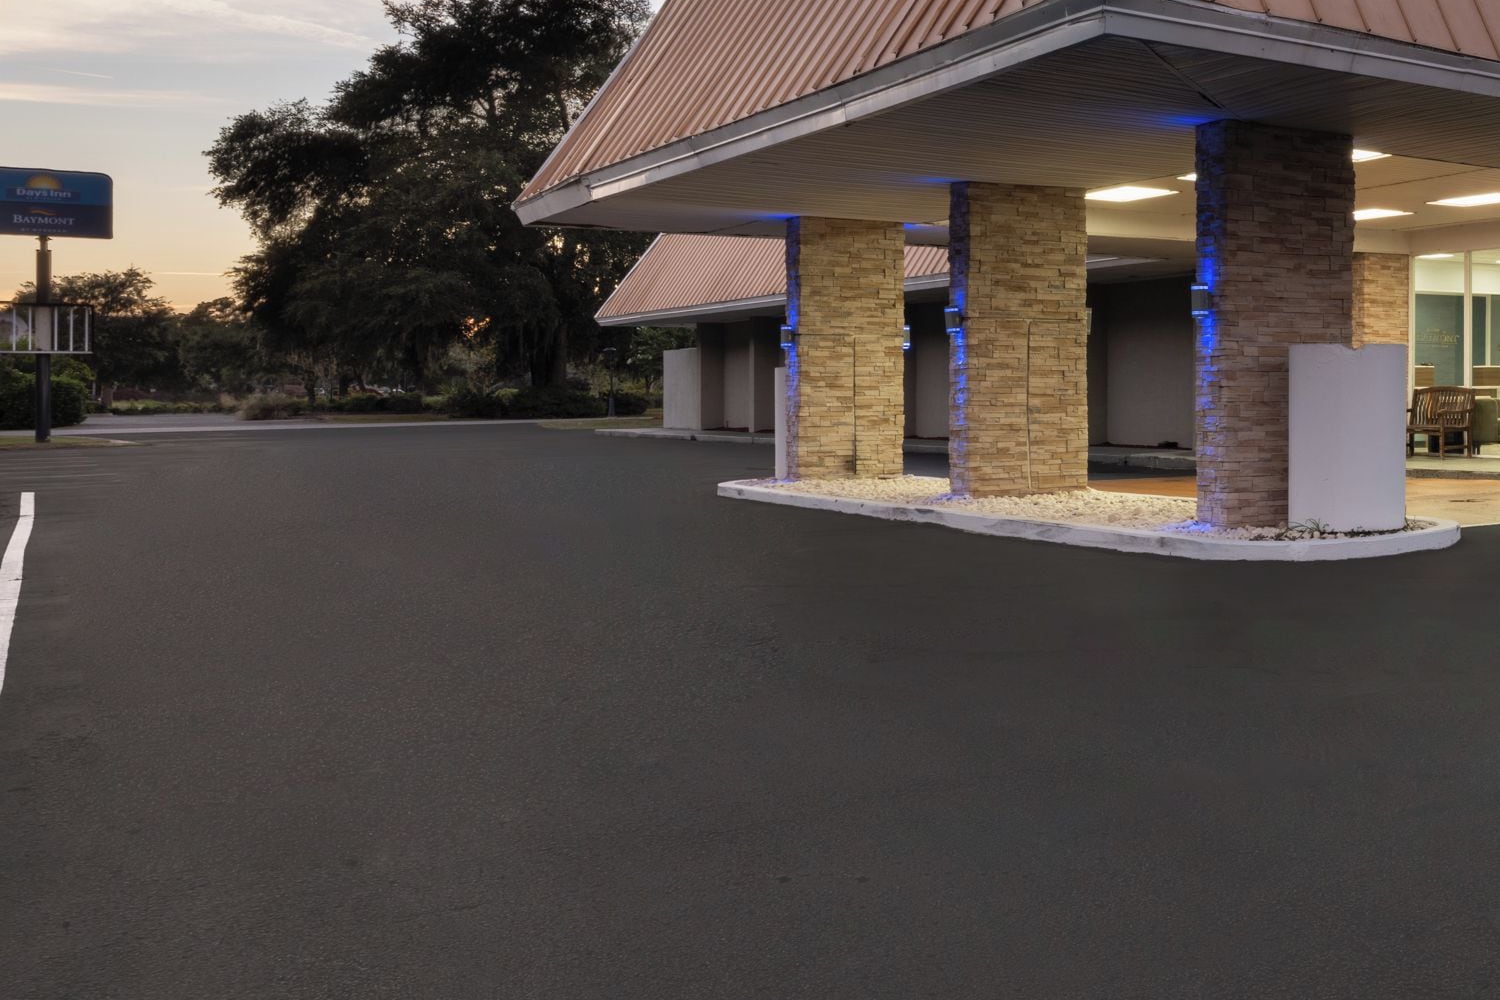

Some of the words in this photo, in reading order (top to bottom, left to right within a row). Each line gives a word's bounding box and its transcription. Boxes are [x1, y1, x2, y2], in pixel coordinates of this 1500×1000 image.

[16, 188, 48, 197] Days
[50, 189, 72, 198] Inn
[12, 214, 76, 226] BAYMONT
